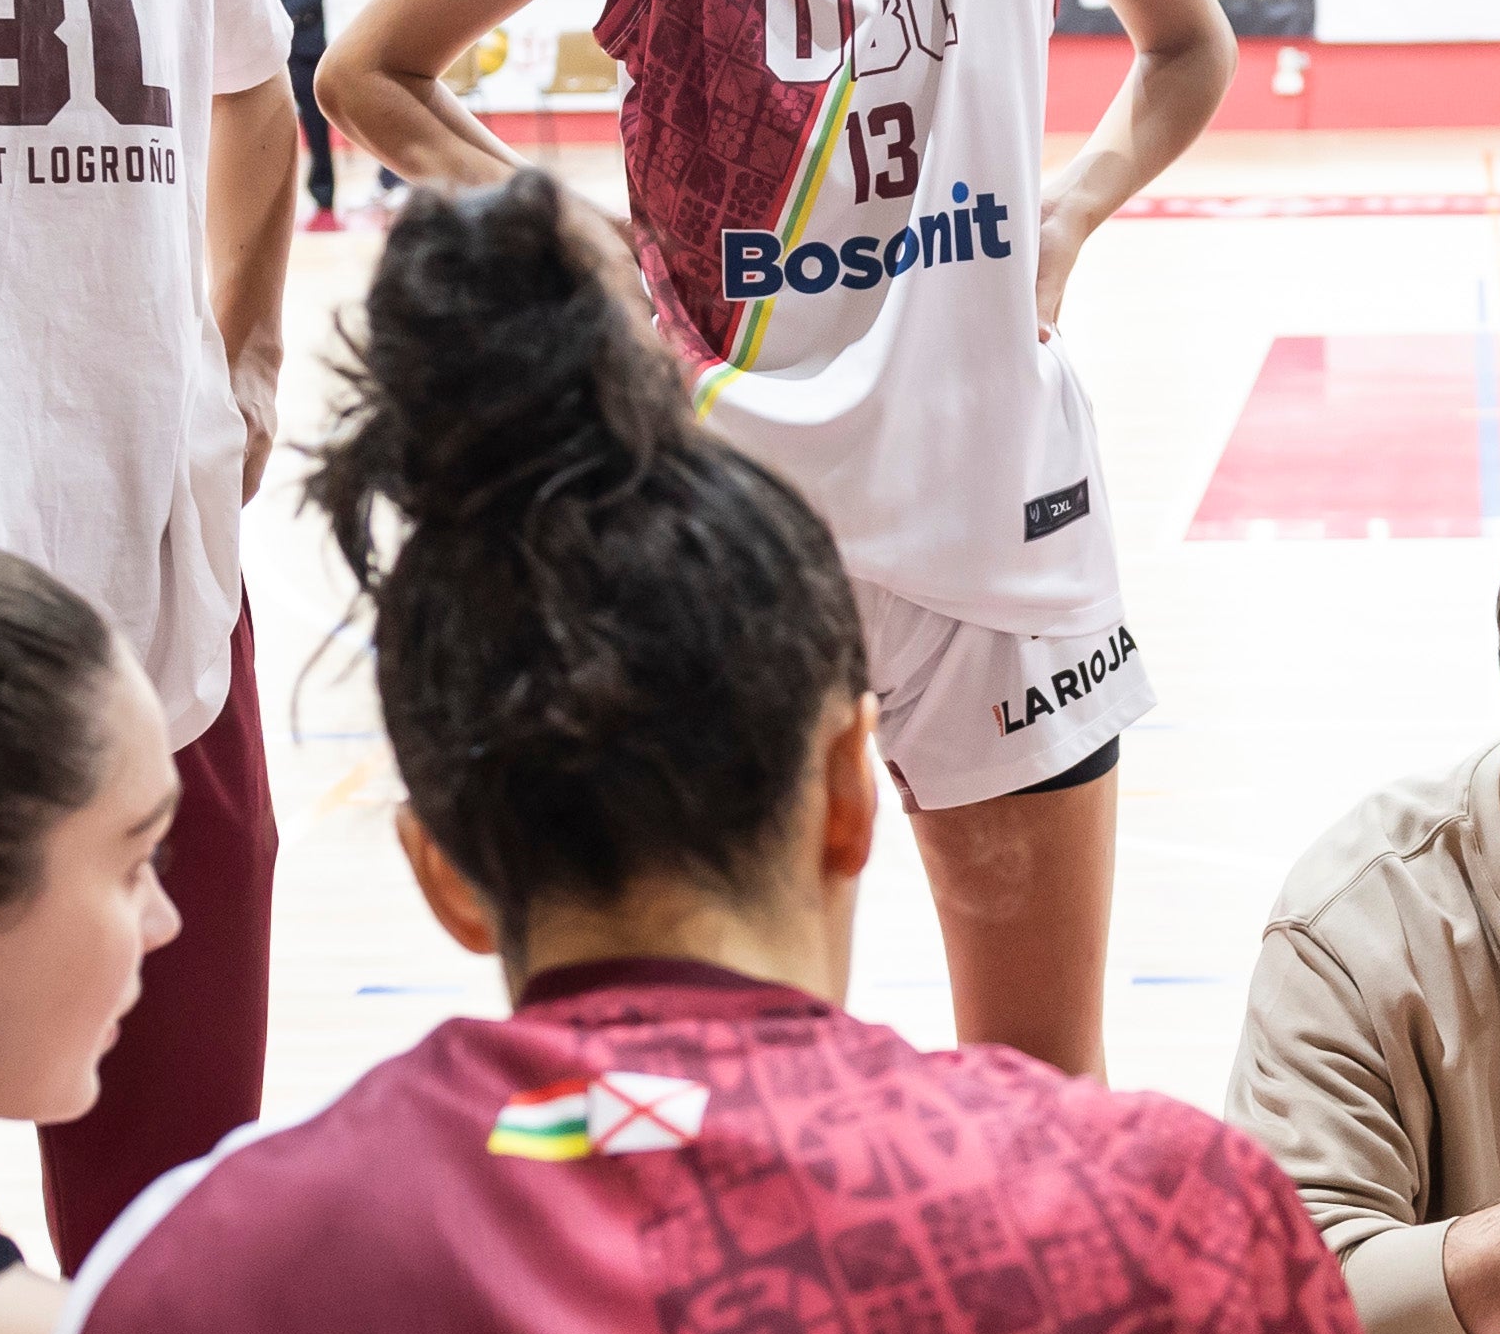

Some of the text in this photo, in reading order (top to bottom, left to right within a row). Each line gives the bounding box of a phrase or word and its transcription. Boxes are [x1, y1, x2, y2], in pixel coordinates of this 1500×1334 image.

[26, 139, 178, 186] LOGROÑO
[845, 101, 920, 206] 13
[721, 180, 1013, 302] Bosonit
[1051, 500, 1072, 517] 2XL
